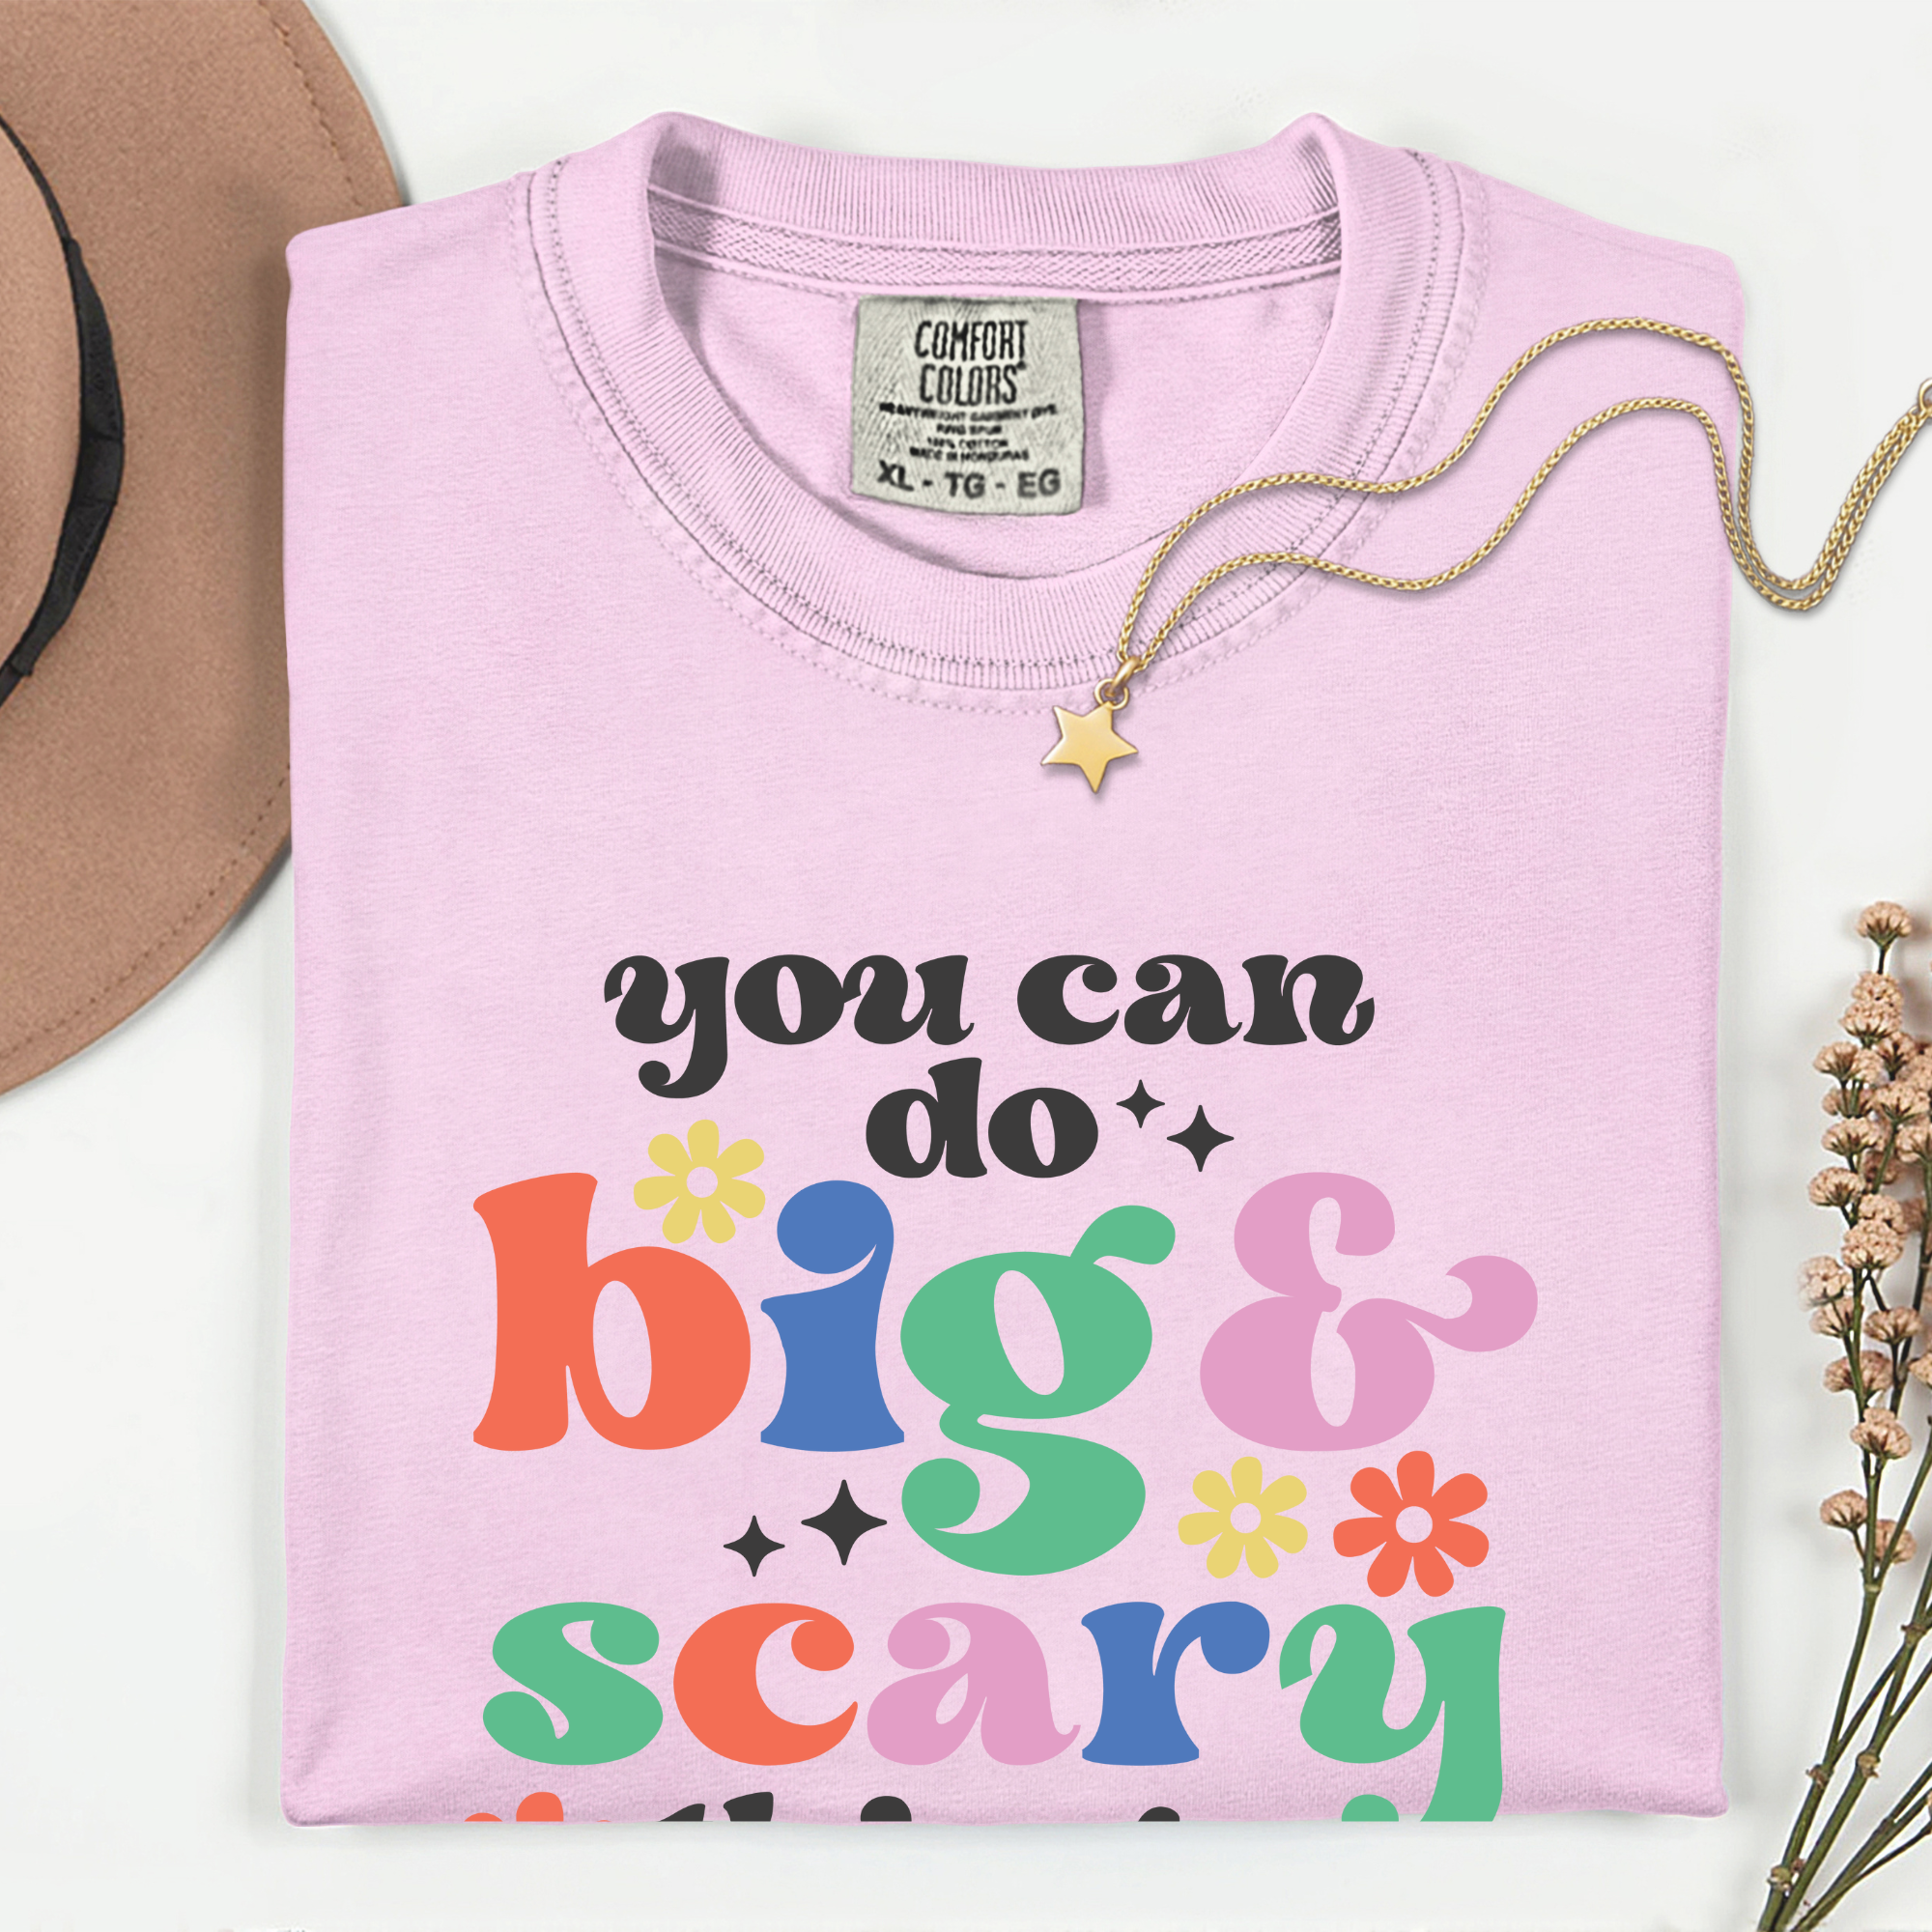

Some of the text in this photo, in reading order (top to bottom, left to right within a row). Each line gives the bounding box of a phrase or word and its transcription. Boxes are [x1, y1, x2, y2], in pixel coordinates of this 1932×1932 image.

[914, 320, 1028, 361] COMFORT
[877, 459, 914, 492] XL
[944, 471, 985, 499] TG
[1016, 469, 1062, 498] EG
[958, 438, 1009, 449] COTTON
[961, 449, 1030, 463] HONDURAS
[604, 954, 1375, 1098] you can
[866, 1057, 1098, 1179] do
[473, 1172, 1538, 1576] big &
[483, 1602, 1506, 1822] scary
